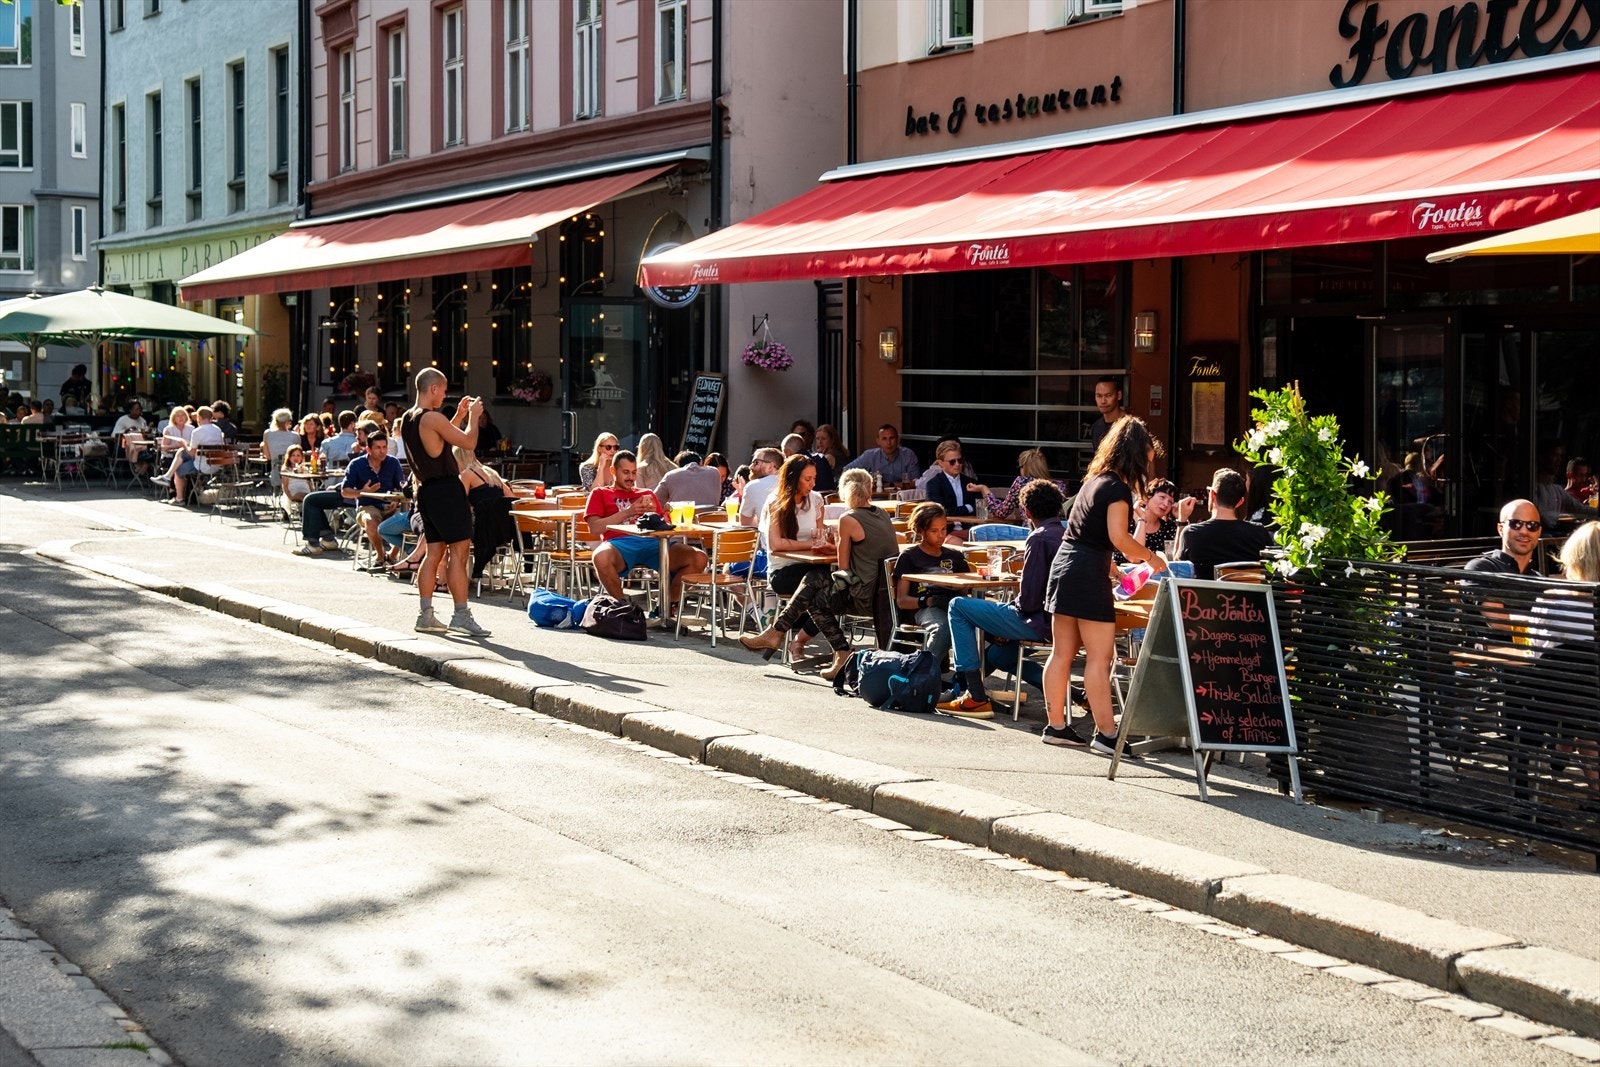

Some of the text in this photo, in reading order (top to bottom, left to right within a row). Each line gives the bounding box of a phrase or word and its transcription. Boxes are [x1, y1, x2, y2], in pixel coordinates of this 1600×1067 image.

[905, 105, 940, 136] bar
[975, 75, 1122, 124] restaurant
[1412, 199, 1483, 230] Fontés
[122, 233, 276, 281] VILLA PARAD
[967, 243, 1009, 266] Fontés
[691, 263, 719, 281] Fontés
[1180, 589, 1264, 622] Bar Fontés
[1199, 626, 1267, 648] Dagens suppe
[1201, 650, 1262, 671] Hjemmelaget
[1239, 667, 1278, 689] Burger
[1204, 681, 1283, 704] Friske Salater
[1211, 708, 1283, 727] Wide selection
[1222, 727, 1234, 743] of
